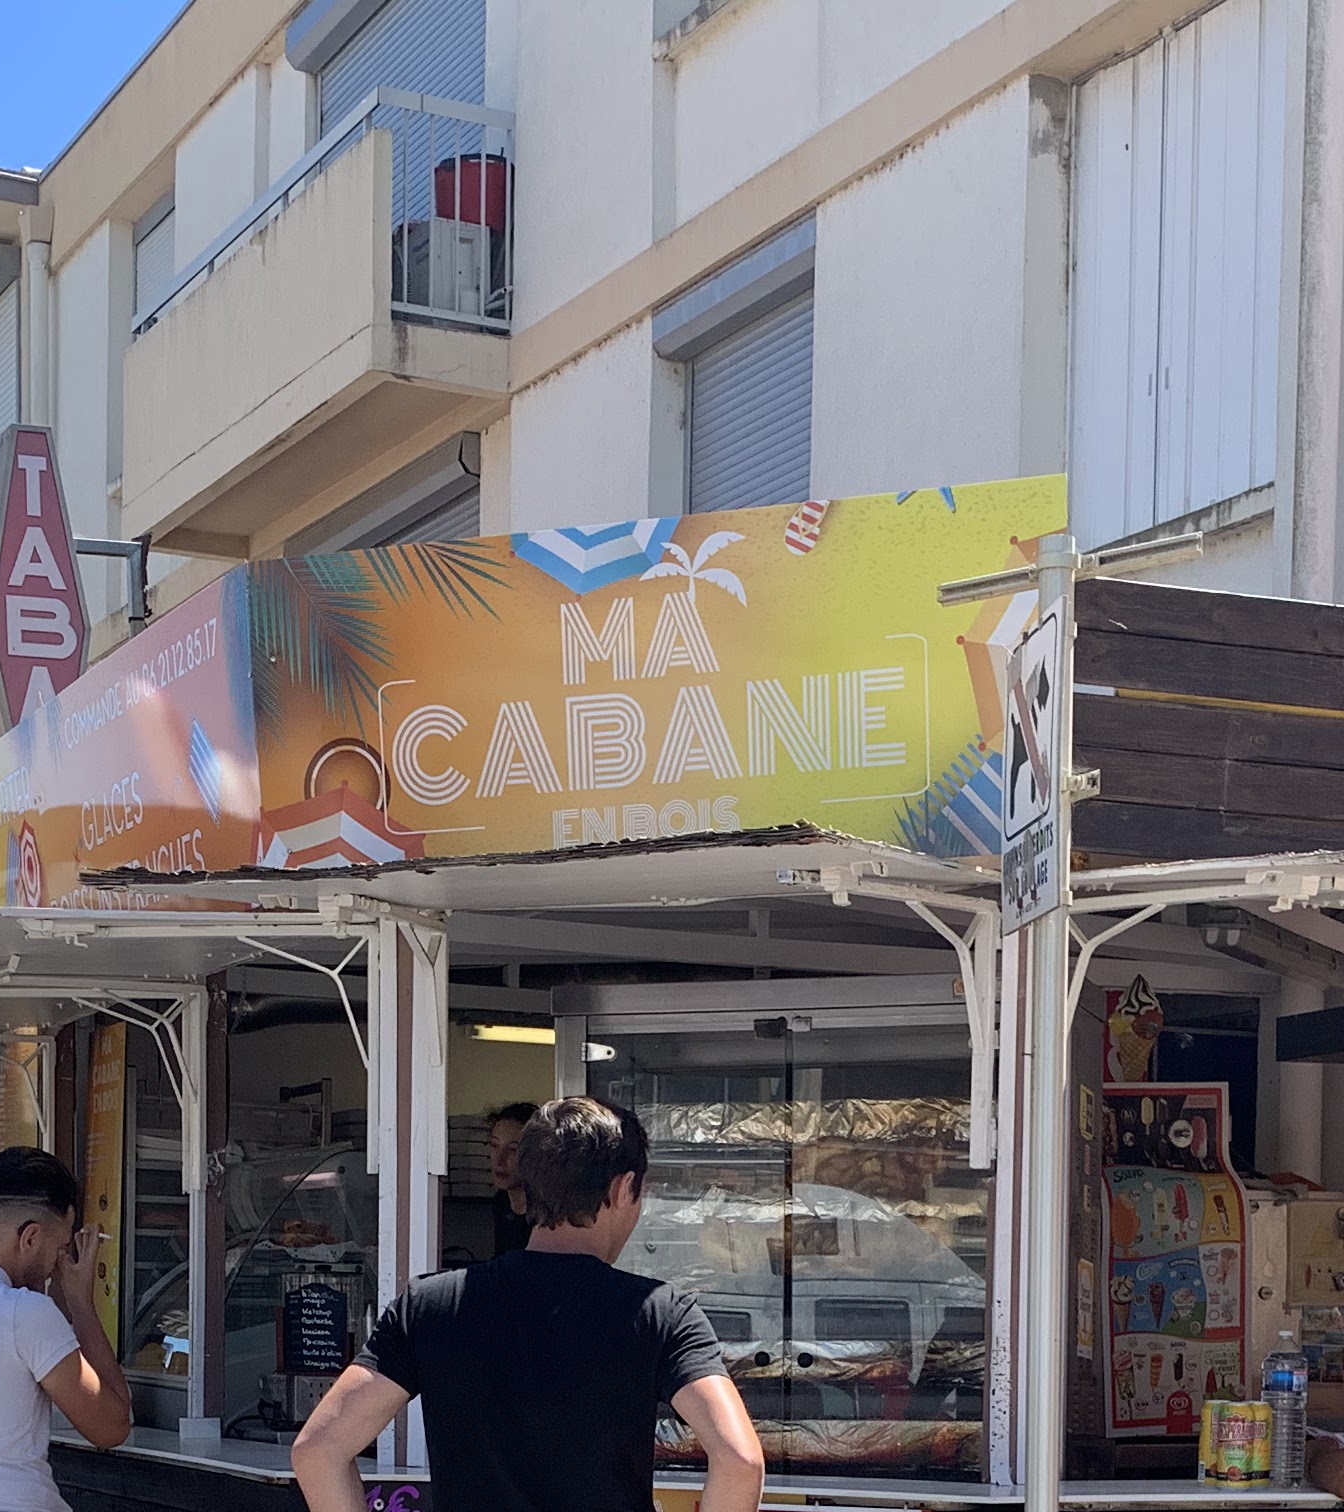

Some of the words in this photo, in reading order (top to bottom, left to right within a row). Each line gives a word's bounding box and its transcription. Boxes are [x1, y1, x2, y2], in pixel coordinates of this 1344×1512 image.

[6, 454, 78, 724] TABA
[560, 592, 720, 686] MA
[64, 681, 123, 750] COMMANDE
[126, 670, 140, 711] AU
[141, 617, 217, 698] 06.21.12.85.17
[391, 667, 906, 806] CABANE
[81, 771, 143, 851] GLACES
[552, 808, 616, 850] EN
[622, 795, 741, 839] BOIS
